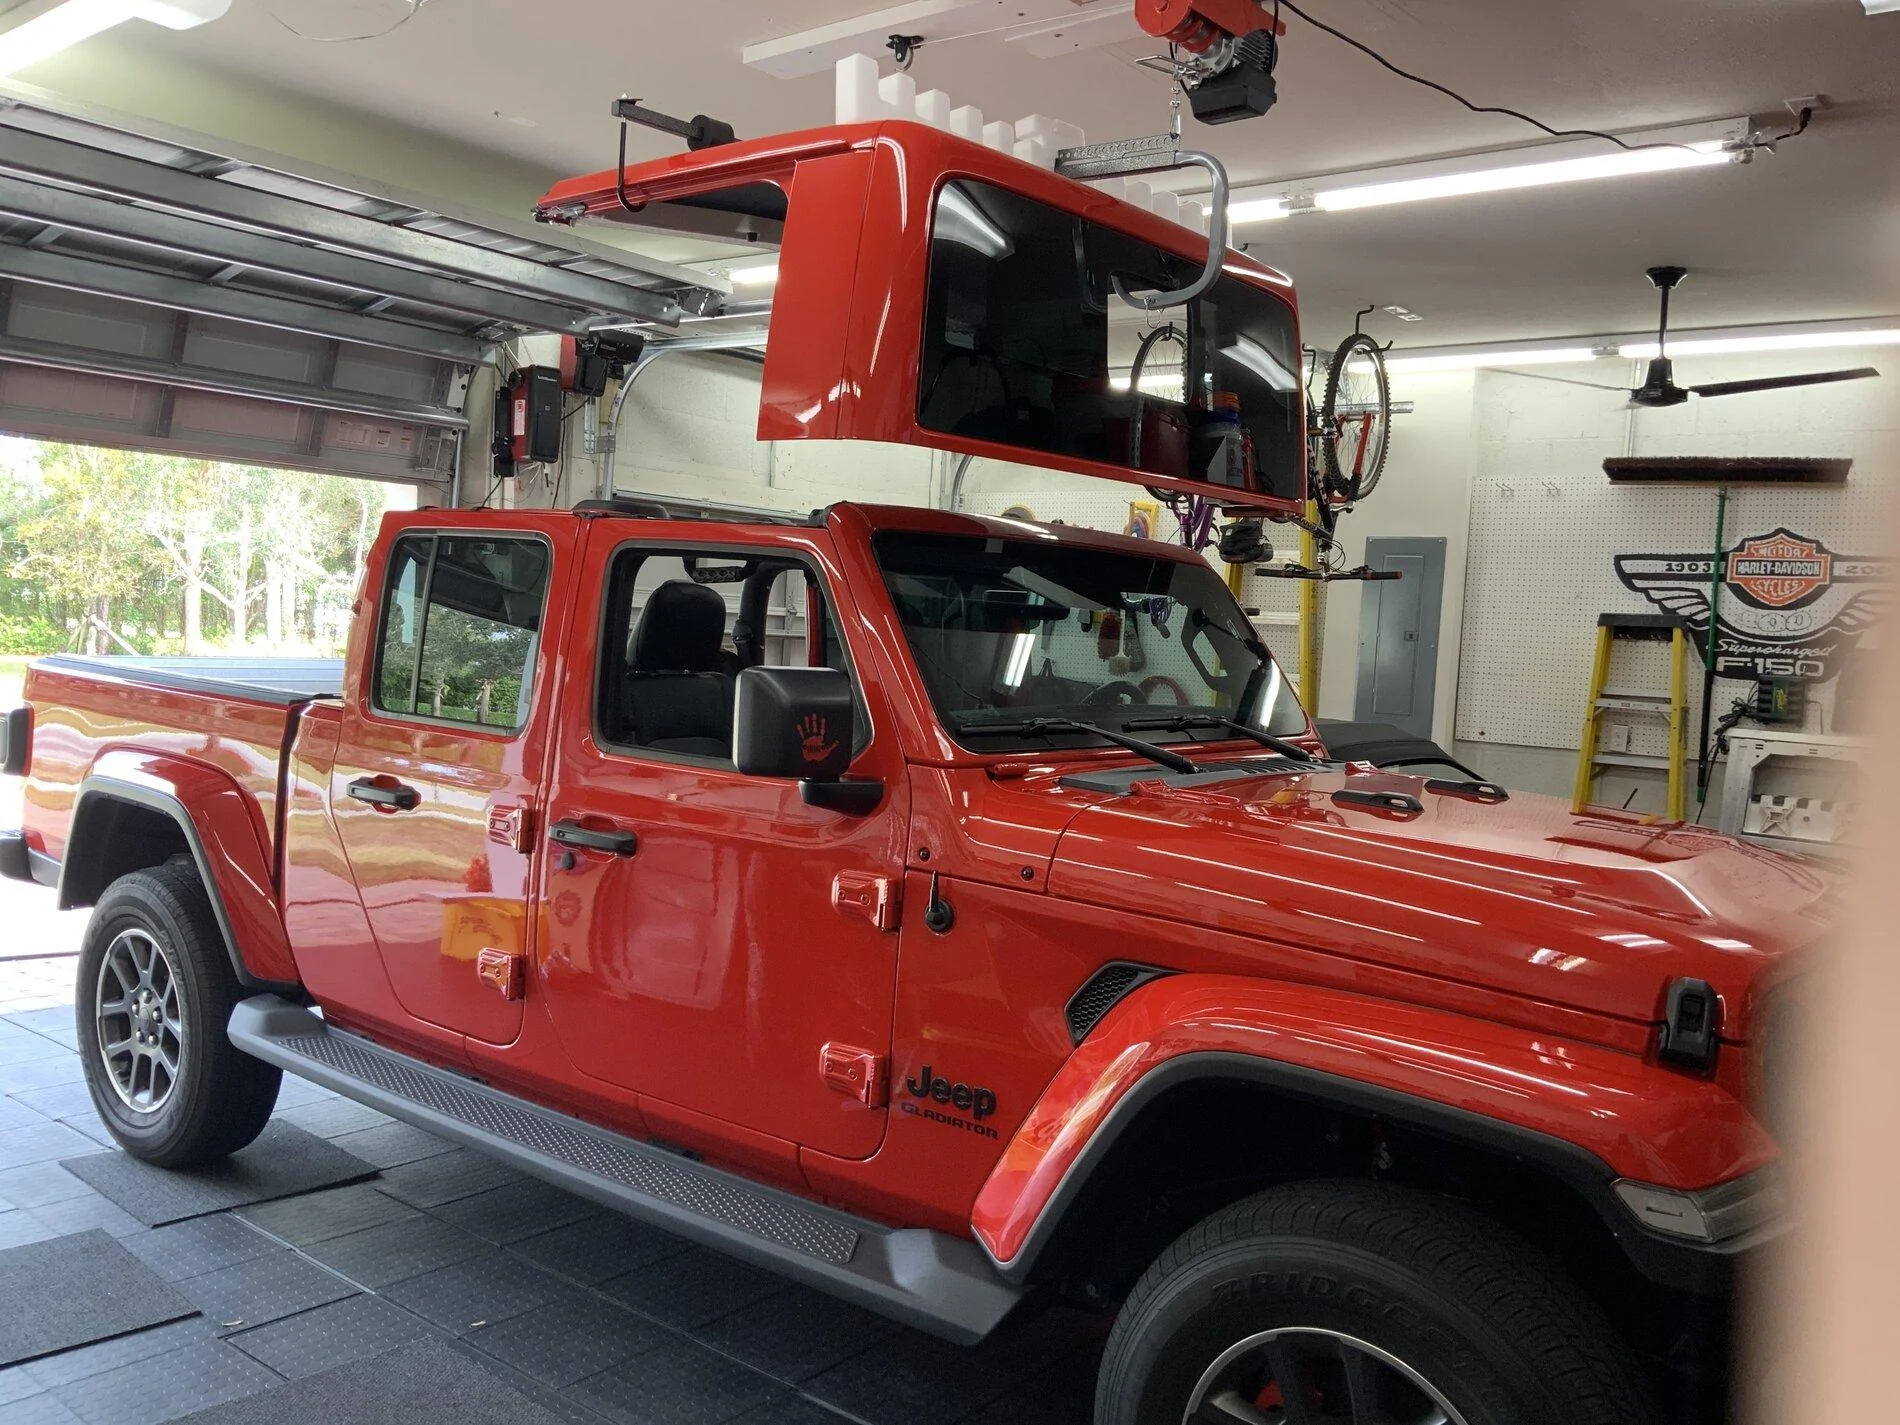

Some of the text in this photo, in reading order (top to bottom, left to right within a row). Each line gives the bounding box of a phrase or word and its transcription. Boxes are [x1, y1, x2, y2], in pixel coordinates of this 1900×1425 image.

[1758, 545, 1802, 557] MOTOR
[1665, 562, 1711, 572] 1903
[1737, 561, 1821, 575] HARLEY-DAVIDSON
[1756, 579, 1801, 596] CYCLES
[1707, 638, 1838, 658] Supercharged
[1715, 656, 1825, 677] F-150
[906, 1064, 997, 1121] Jeep
[901, 1102, 999, 1140] GLADIATOR
